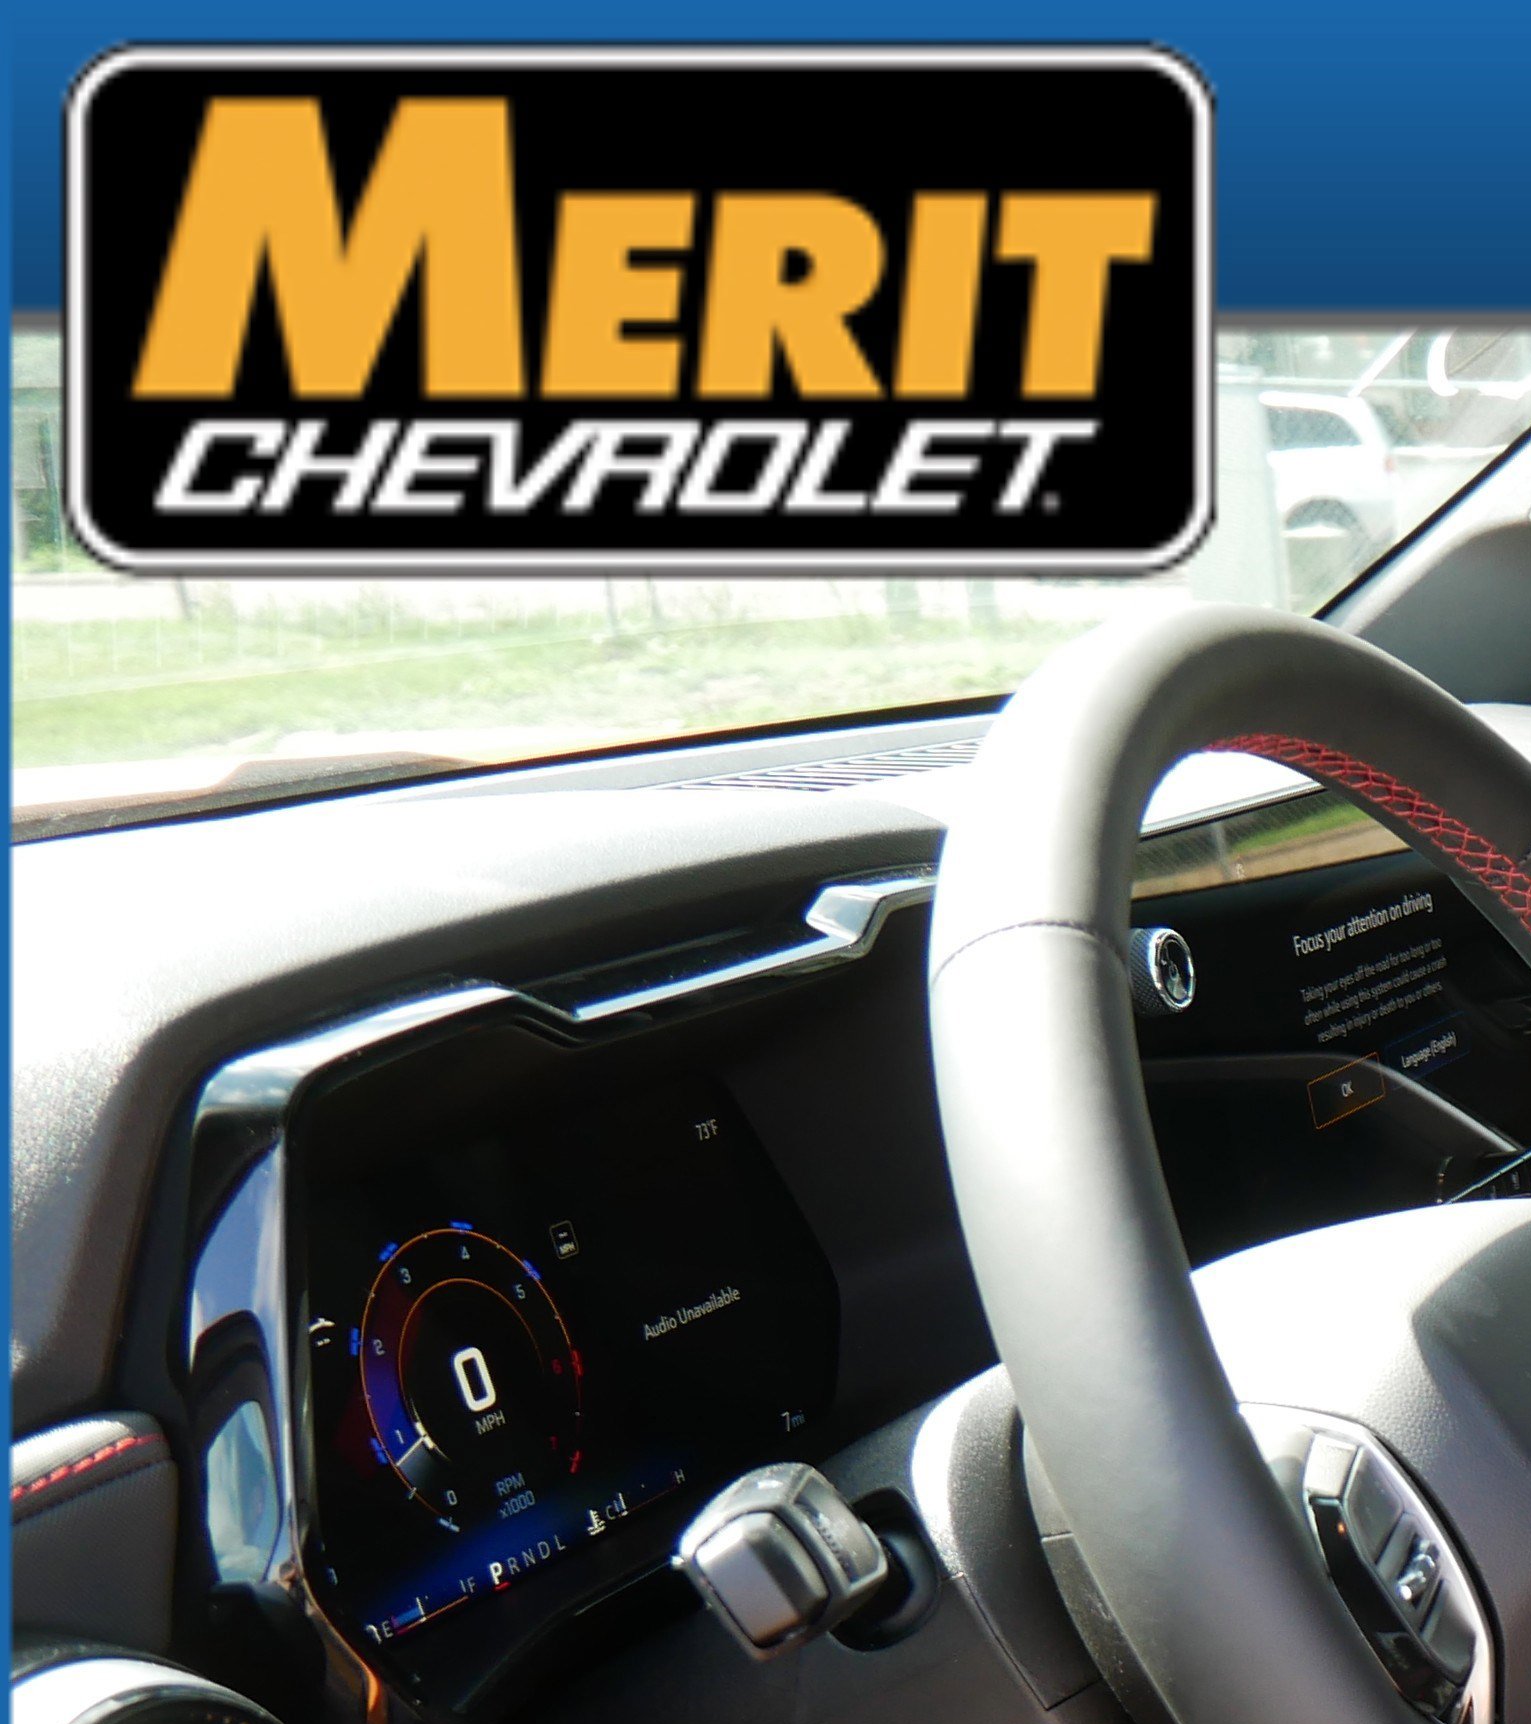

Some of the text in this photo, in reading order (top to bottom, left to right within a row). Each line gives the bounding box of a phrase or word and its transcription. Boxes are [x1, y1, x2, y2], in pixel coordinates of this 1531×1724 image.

[1293, 892, 1433, 956] Focus your attention on driving
[1401, 1031, 1457, 1068] Language (English)
[1341, 1080, 1354, 1097] OK
[460, 1246, 471, 1260] 4
[400, 1267, 412, 1284] 3
[515, 1284, 526, 1300] 5
[643, 1286, 741, 1341] Audio Unavailable
[372, 1339, 386, 1356] 2
[454, 1346, 496, 1412] 0
[475, 1409, 506, 1435] MPH
[395, 1429, 405, 1444] 1
[496, 1472, 526, 1497] RPM
[673, 1469, 686, 1484] H
[446, 1490, 458, 1506] 0
[499, 1490, 536, 1519] x1000
[605, 1504, 616, 1521] C
[381, 1620, 394, 1639] E
